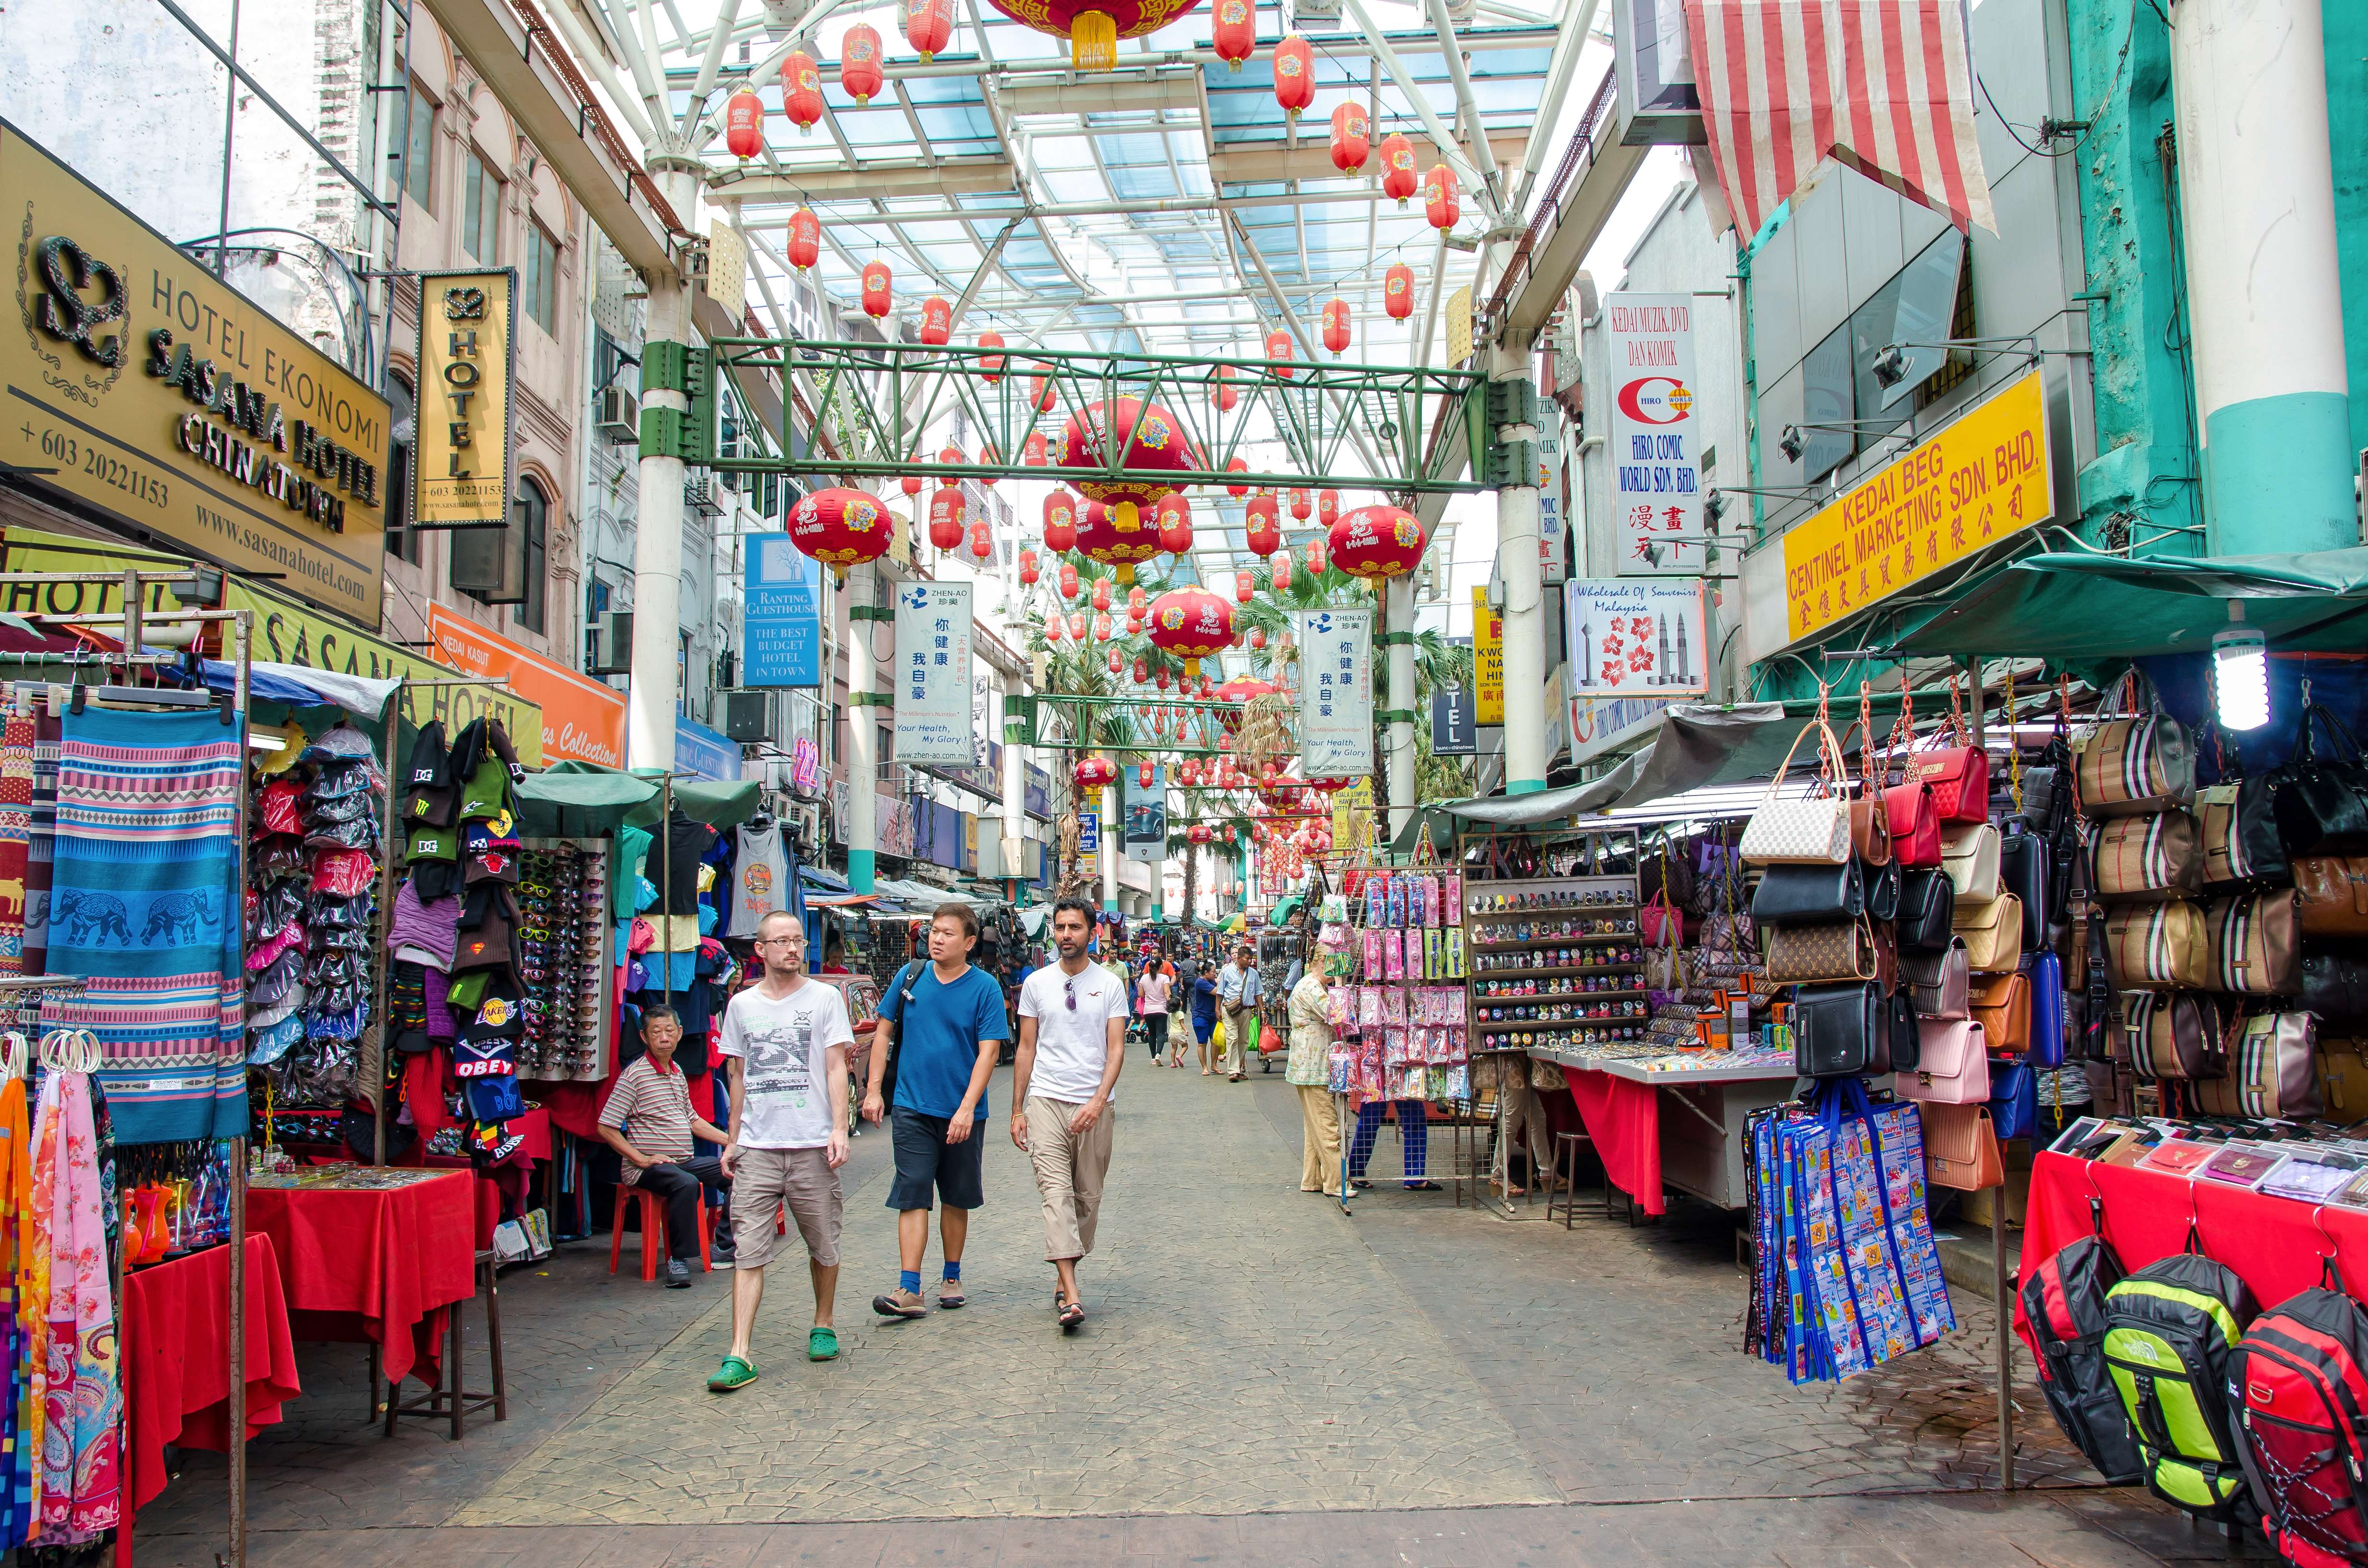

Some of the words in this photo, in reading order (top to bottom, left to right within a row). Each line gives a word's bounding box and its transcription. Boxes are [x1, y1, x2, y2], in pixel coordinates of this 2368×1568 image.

[1612, 307, 1638, 332] KEDAI
[1640, 307, 1670, 336] MUZIK,
[1672, 307, 1689, 331] DVD
[153, 269, 250, 370] HOTEL
[265, 348, 379, 453] EKONOMI
[1628, 341, 1646, 366] DAN
[1648, 341, 1678, 366] KOMIK
[444, 331, 479, 478] HOTEL
[1537, 400, 1555, 416] ZIK,
[147, 328, 288, 453] SASANA
[294, 420, 381, 508] HOTEL
[1631, 434, 1653, 460] HIRO
[1656, 434, 1684, 460] COMIC
[41, 429, 77, 465] 603
[84, 449, 169, 508] 20221153
[179, 413, 345, 534] CHINATOWN
[1620, 466, 1650, 492] WORLD
[1654, 466, 1673, 493] SDN.
[1677, 467, 1698, 493] BHD.
[1843, 477, 1895, 531] KEDAI
[1903, 442, 1943, 495] BEG
[453, 485, 501, 496] 20221153
[1542, 498, 1557, 514] MIC
[1789, 541, 1851, 600] CENTINEL
[1854, 485, 1942, 567] MARKETING
[1949, 457, 1991, 512] SDN.
[1995, 429, 2039, 487] BHD.
[195, 504, 365, 602] www.sasanahotel.com
[1578, 585, 1629, 597] Wholesale
[1633, 586, 1645, 600] Of
[1652, 586, 1697, 597] Souvenirs
[1595, 600, 1649, 616] Malaysia
[755, 628, 778, 638] THE
[780, 627, 808, 638] BEST
[935, 618, 949, 666] 你健康
[444, 635, 465, 657] KEDAI
[468, 645, 489, 667] KASUT
[758, 640, 804, 651] BUDGET
[762, 652, 801, 664] HOTEL
[1340, 641, 1353, 685] 你健康
[756, 667, 767, 677] IN
[769, 666, 806, 677] TOWN
[912, 652, 926, 700] 我自豪
[1320, 673, 1332, 717] 我自豪
[897, 724, 916, 733] Your
[919, 724, 951, 734] Health,
[1596, 707, 1608, 739] HIRO
[1609, 699, 1625, 734] COMIC
[560, 722, 617, 767] Collection
[923, 735, 936, 745] My
[938, 735, 962, 745] Glory
[1327, 738, 1357, 748] Health,
[896, 752, 969, 762] www.zhen-ao.com.my
[1331, 749, 1342, 758] My
[1344, 749, 1366, 758] Glory
[1307, 764, 1372, 773] www.zhen-ao.com.my
[1034, 773, 1045, 790] centre
[482, 1004, 513, 1017] LAKERS
[458, 1060, 513, 1077] OBEY
[494, 1094, 518, 1112] BOY
